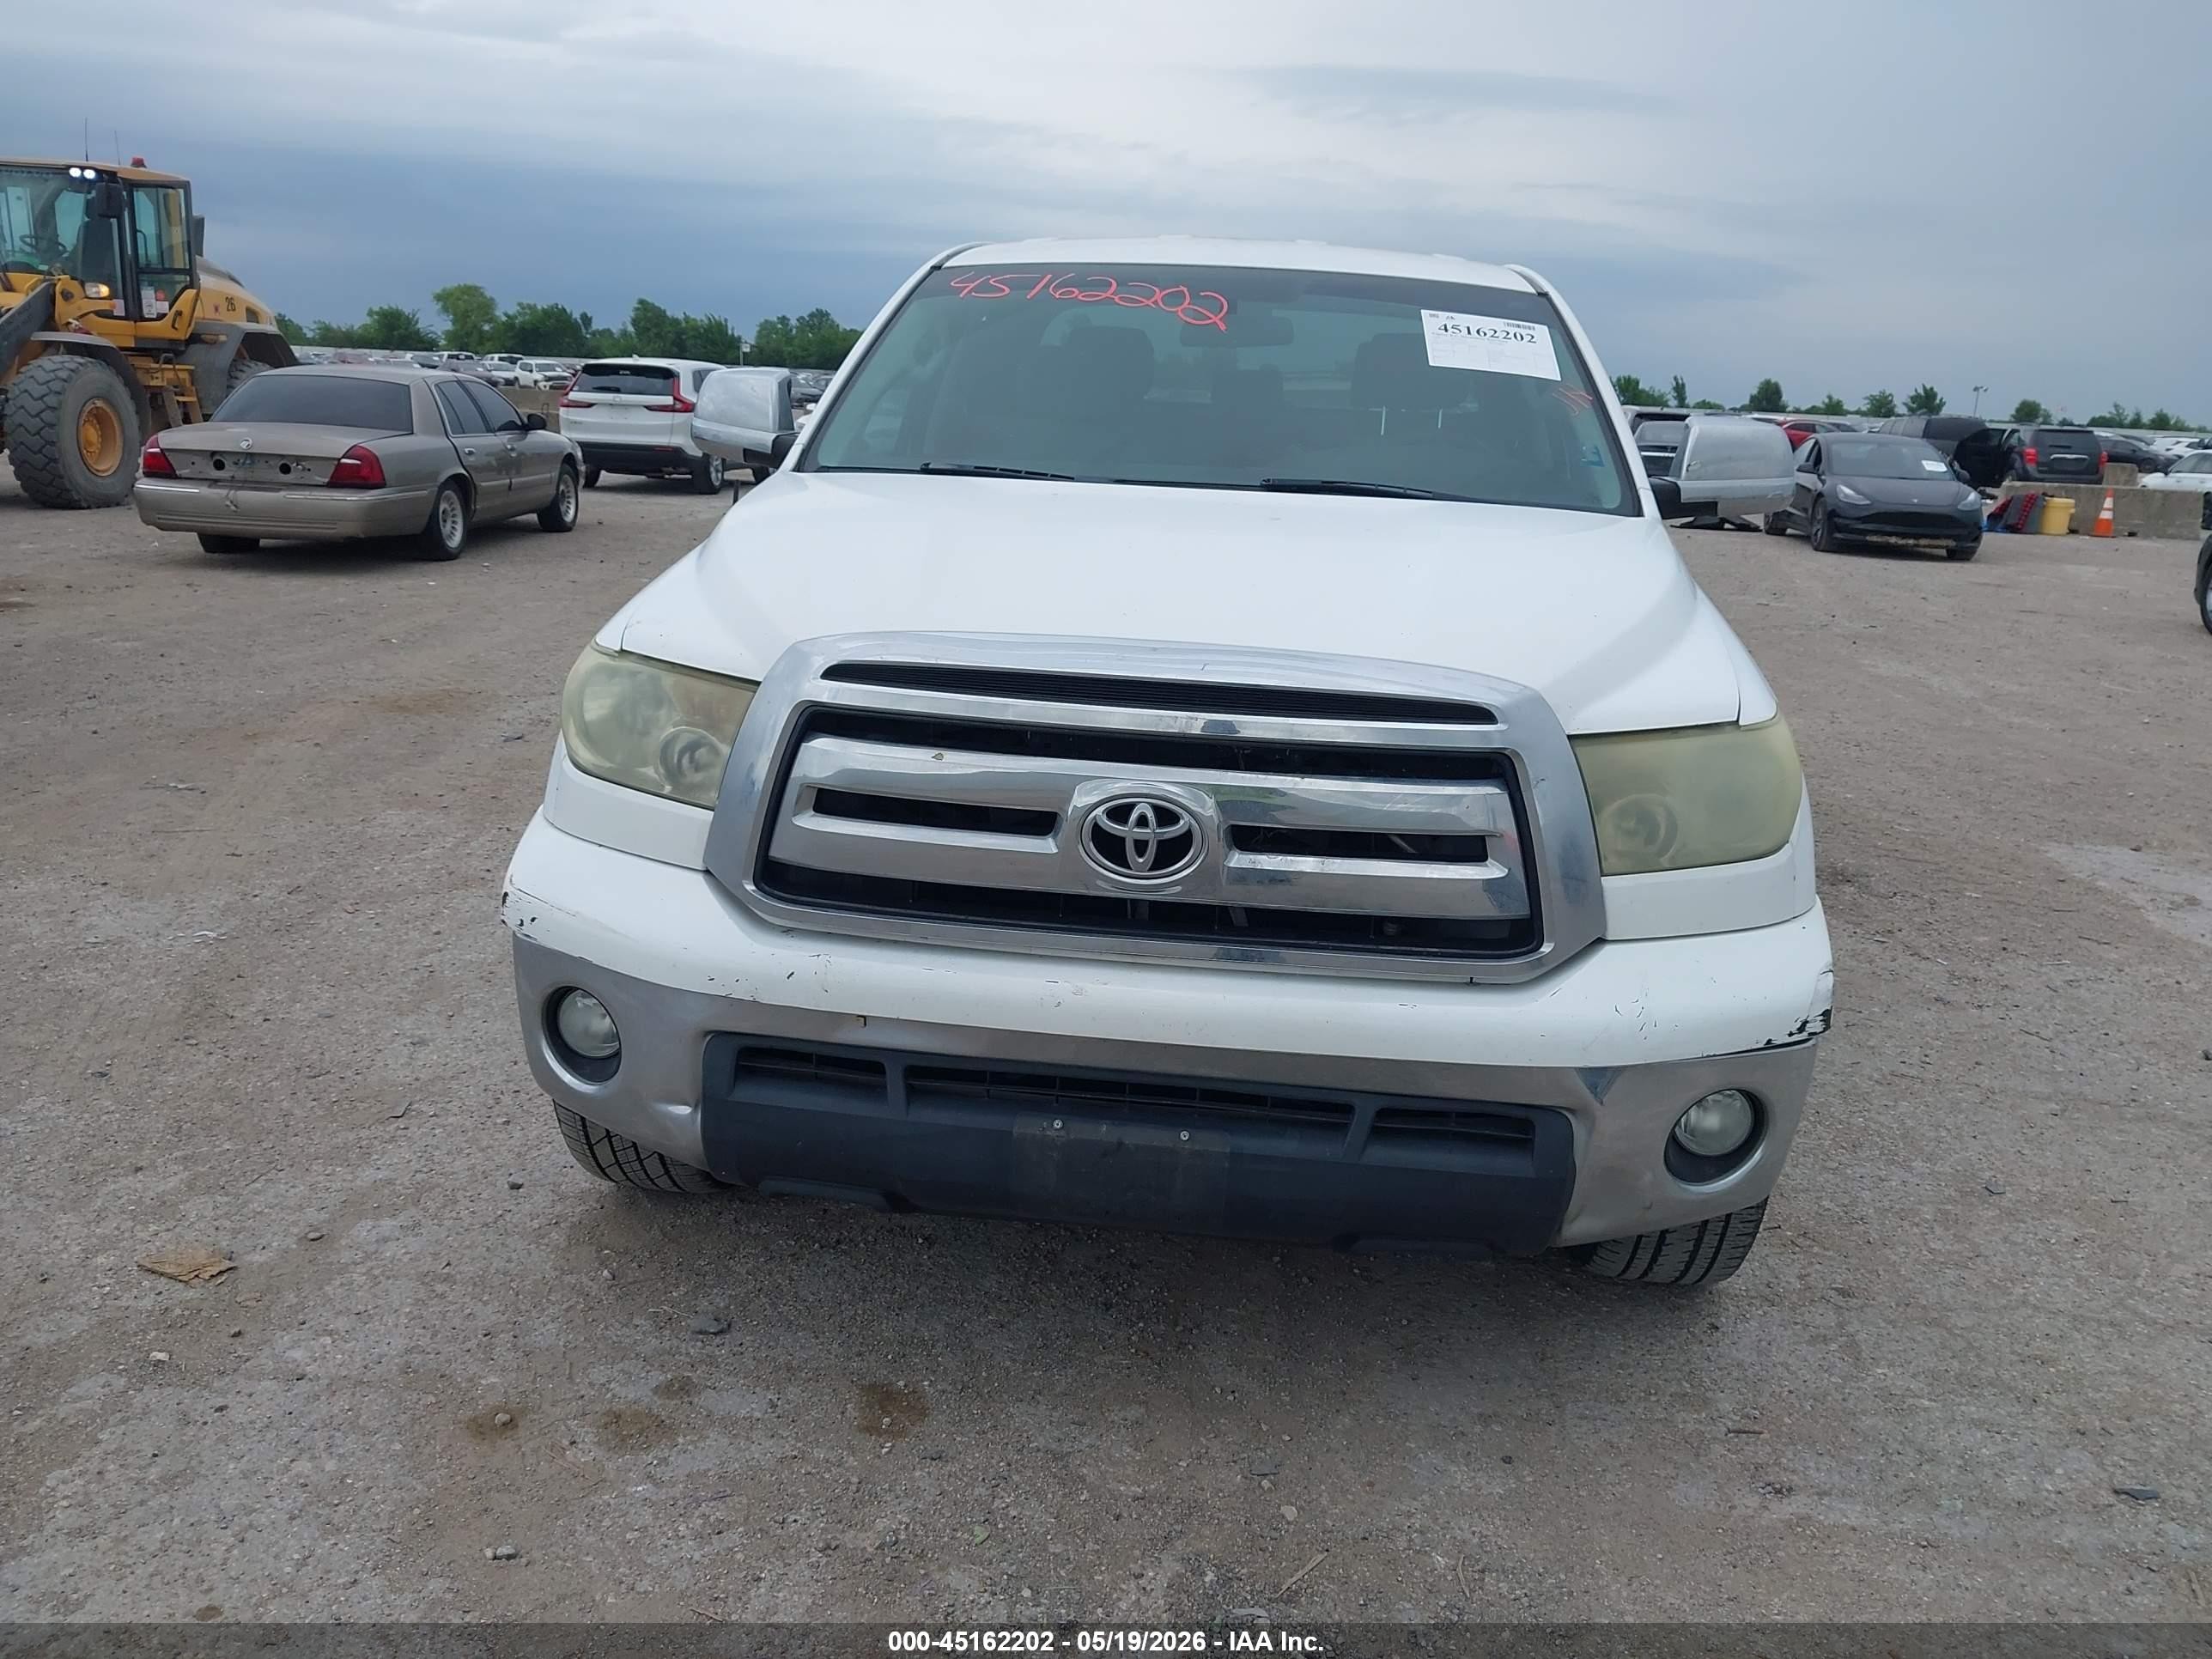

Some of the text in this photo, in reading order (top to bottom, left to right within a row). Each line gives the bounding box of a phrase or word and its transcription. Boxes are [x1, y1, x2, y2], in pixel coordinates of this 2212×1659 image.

[225, 296, 236, 312] 26
[951, 272, 1228, 331] 45162202
[1438, 324, 1537, 343] 45162202
